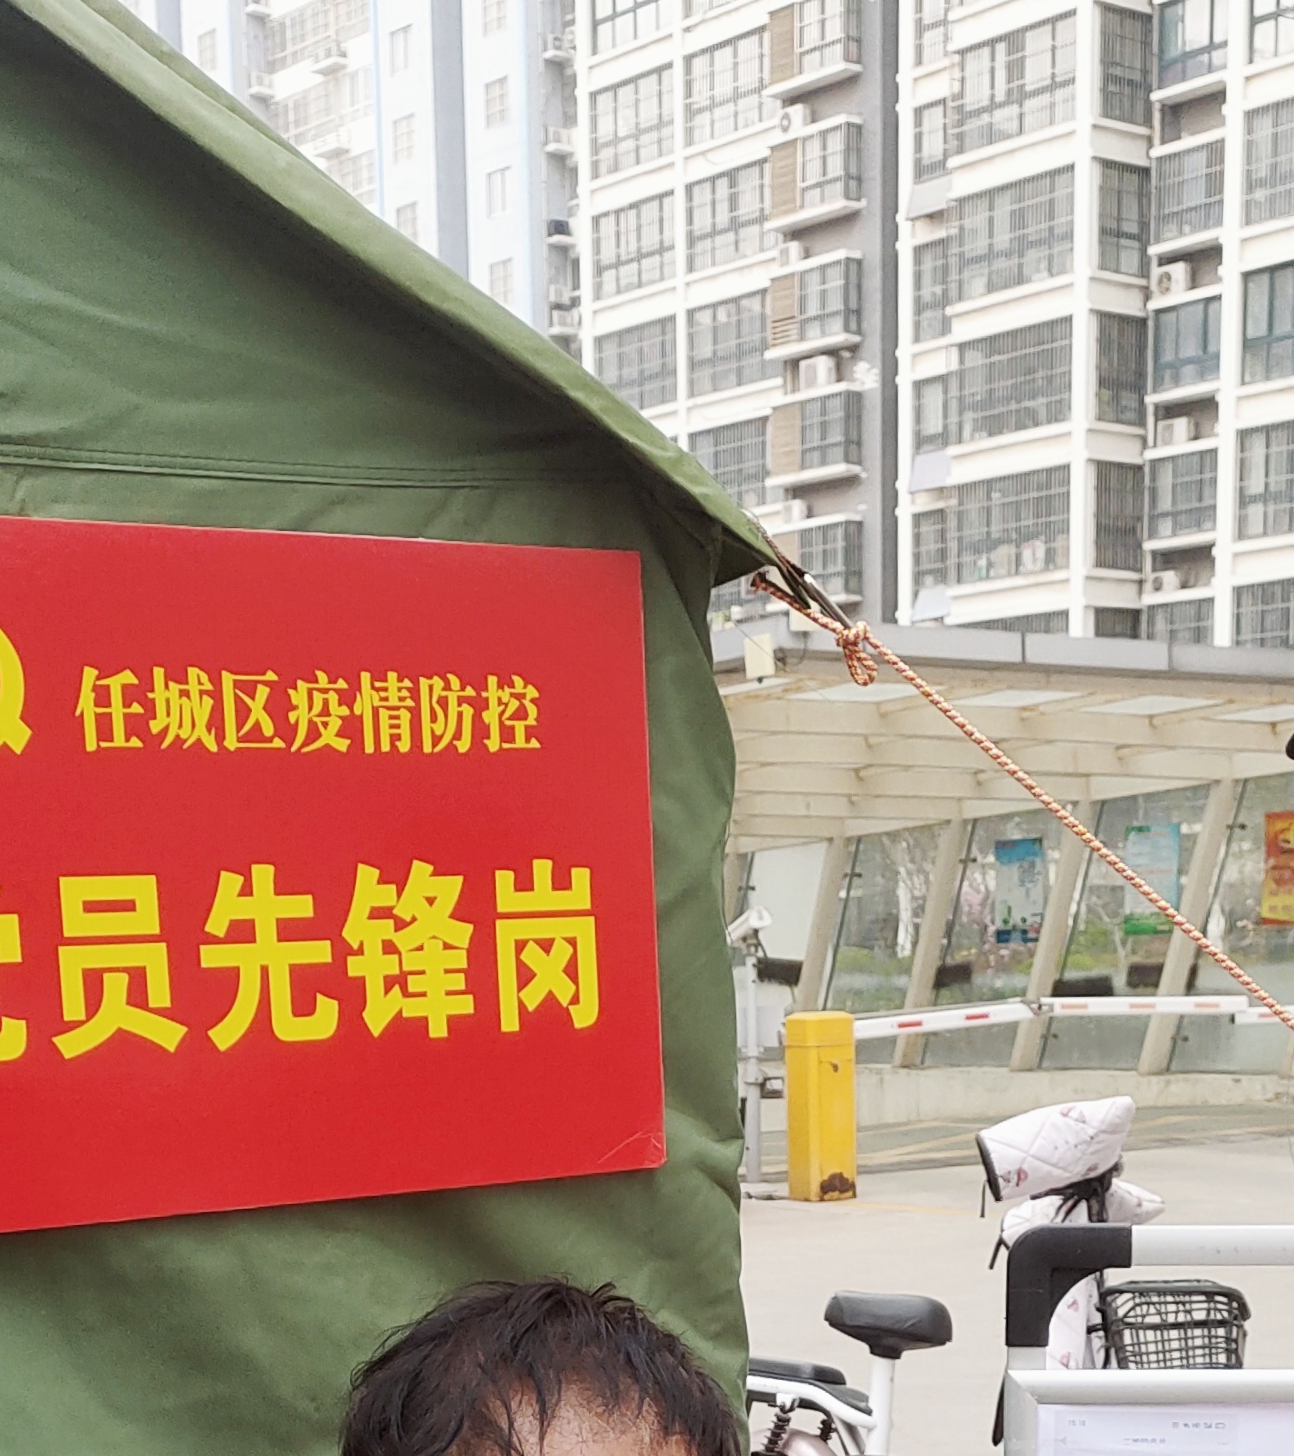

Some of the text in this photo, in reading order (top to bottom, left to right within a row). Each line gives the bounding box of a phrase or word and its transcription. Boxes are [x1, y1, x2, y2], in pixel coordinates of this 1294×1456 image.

[75, 665, 541, 753] 任城区疫情防控
